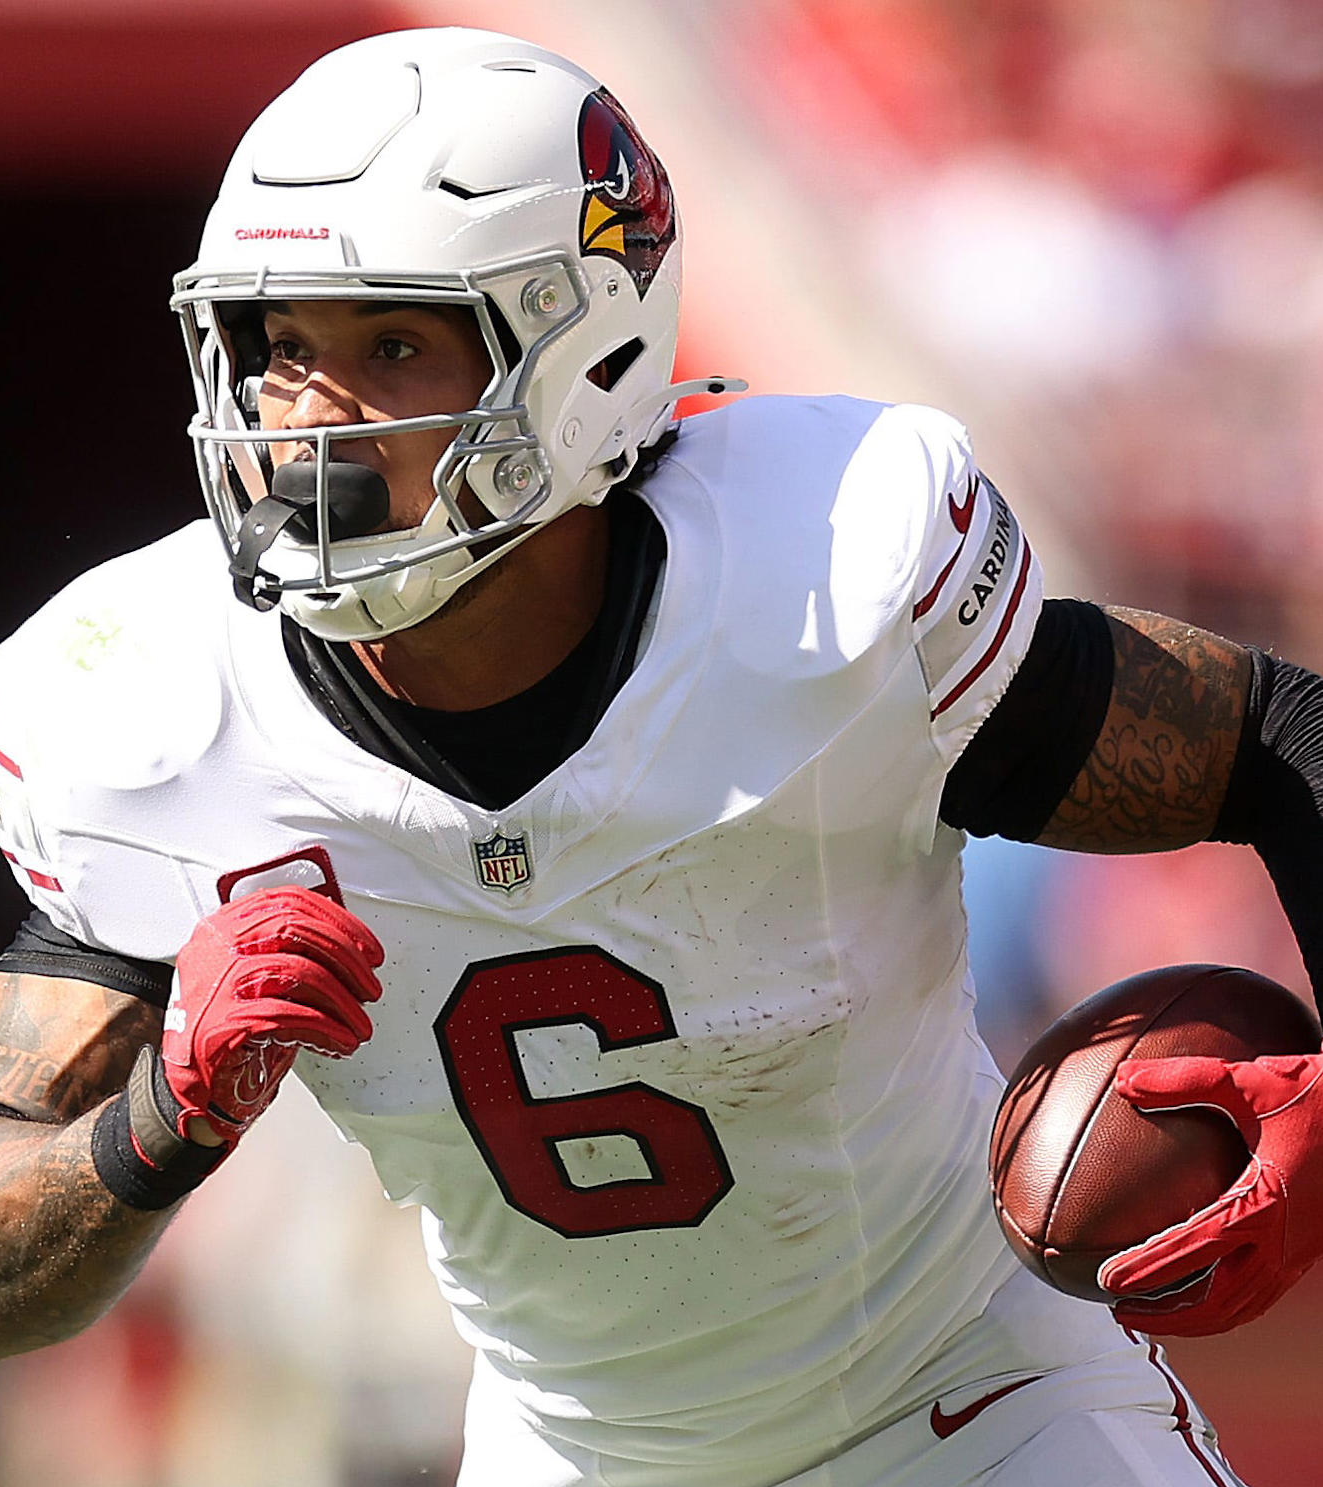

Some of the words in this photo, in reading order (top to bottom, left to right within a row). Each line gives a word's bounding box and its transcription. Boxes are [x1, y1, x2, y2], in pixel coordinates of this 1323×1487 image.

[234, 227, 330, 241] CARDINALS
[483, 857, 526, 885] NFL
[432, 944, 735, 1240] 6
